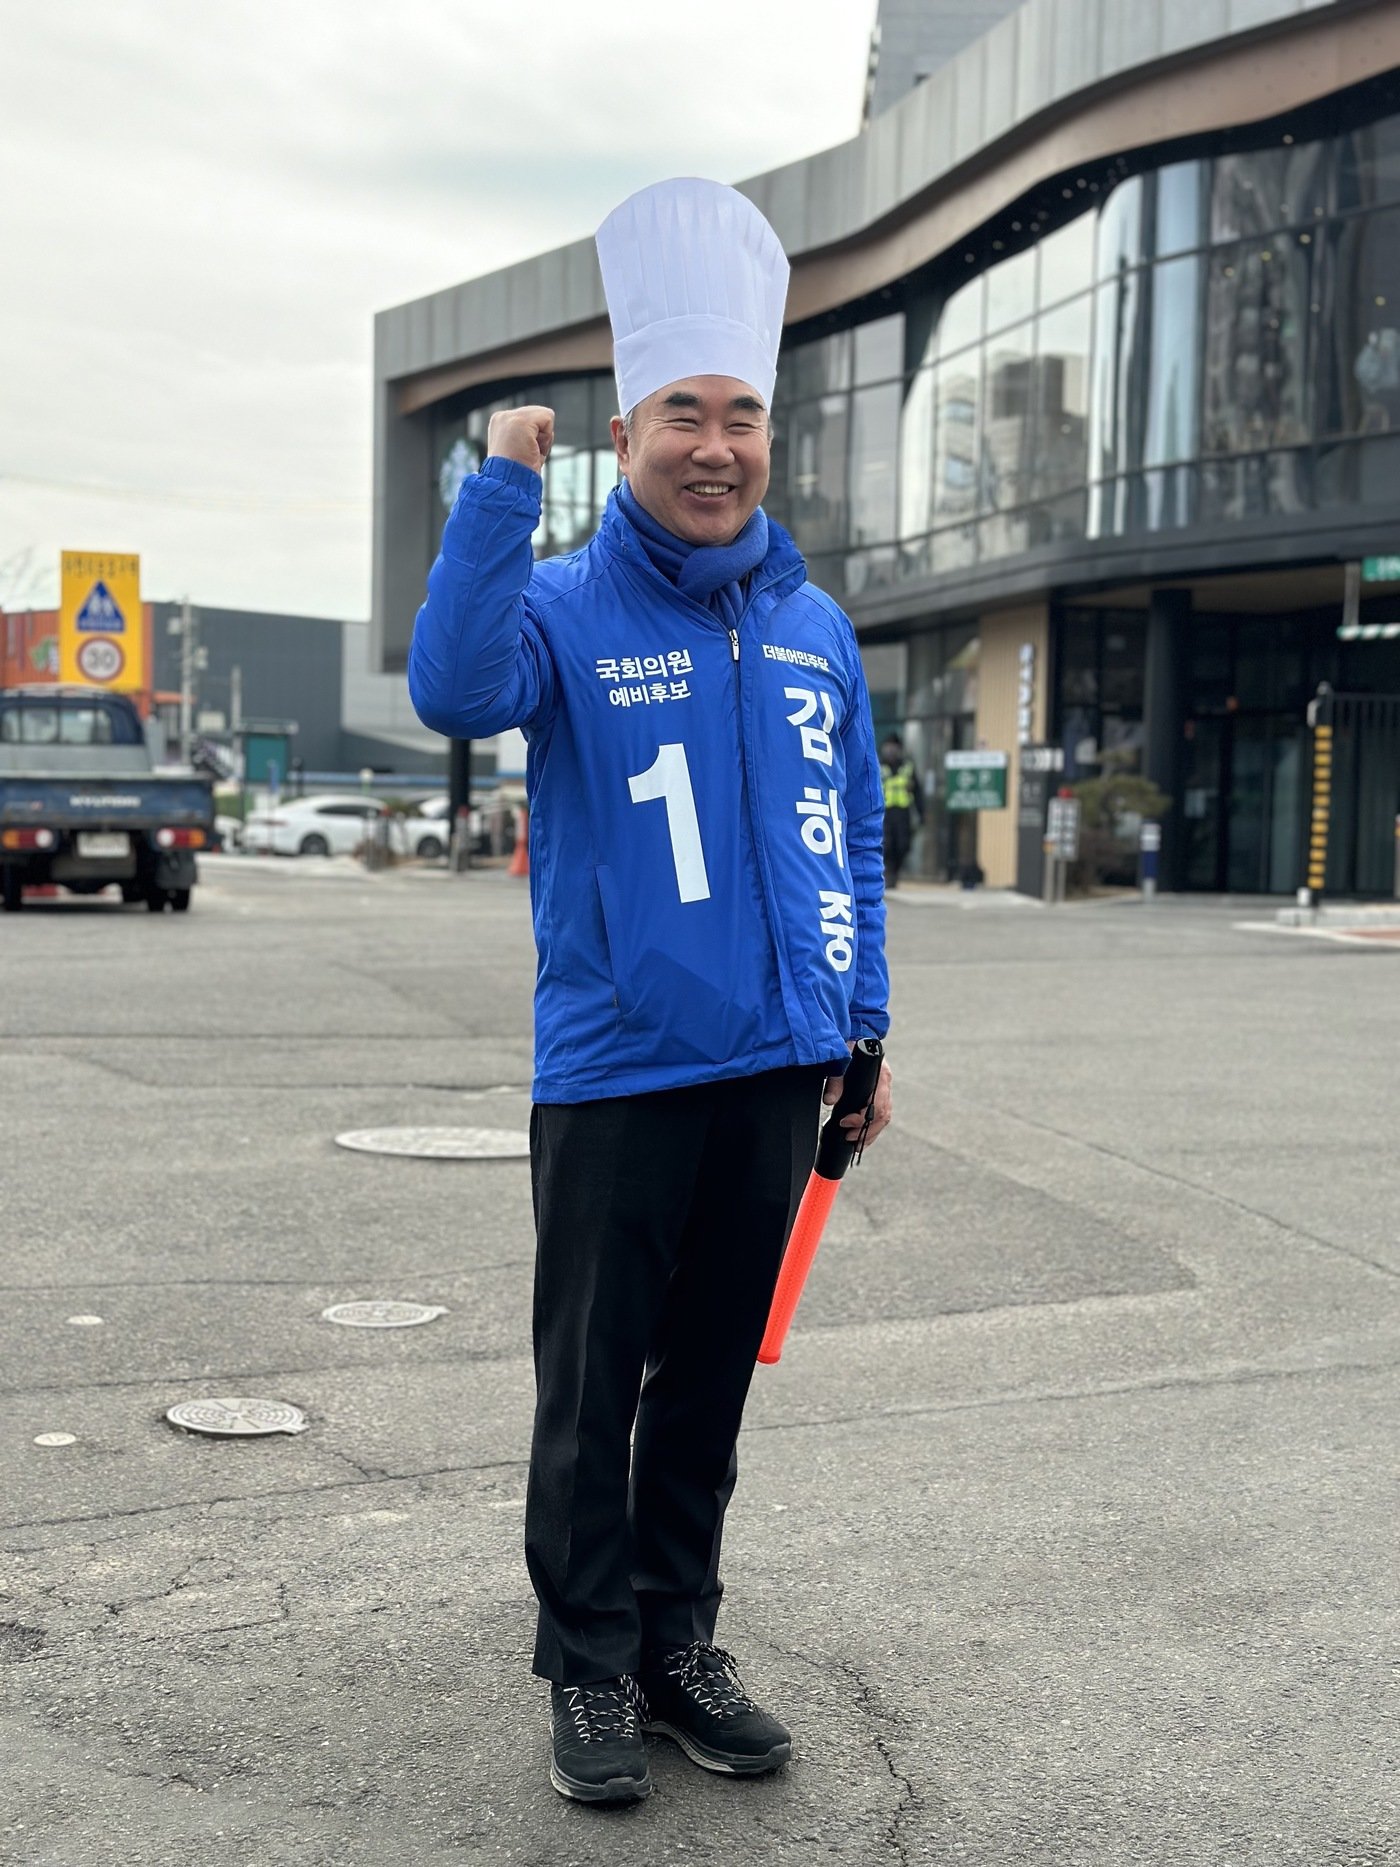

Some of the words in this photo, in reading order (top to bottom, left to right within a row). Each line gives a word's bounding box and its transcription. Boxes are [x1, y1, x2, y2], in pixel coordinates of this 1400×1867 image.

[595, 649, 694, 682] 국회의원
[762, 644, 830, 672] 더불어민주당
[609, 679, 692, 707] 예비후보
[627, 742, 711, 904] 1
